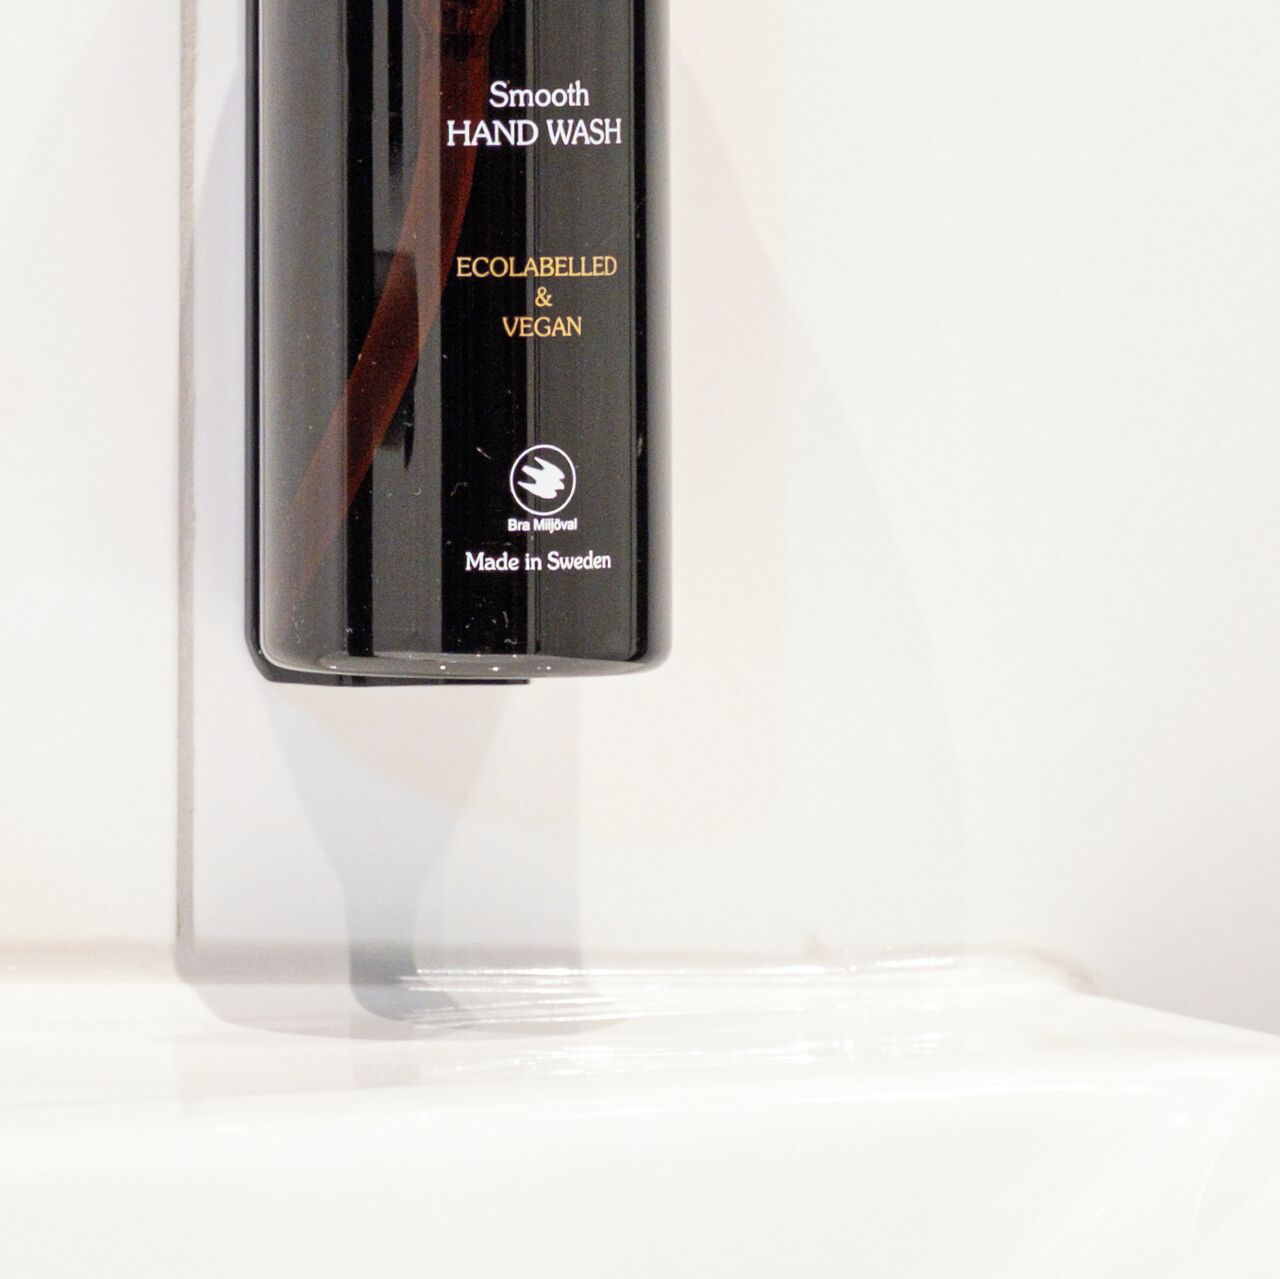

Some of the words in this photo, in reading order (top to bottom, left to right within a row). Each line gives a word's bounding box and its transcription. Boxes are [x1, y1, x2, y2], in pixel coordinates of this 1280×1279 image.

[489, 80, 589, 107] Smooth
[446, 120, 539, 146] HAND
[546, 118, 622, 145] WASH
[456, 256, 617, 277] ECOLABELLED
[535, 287, 552, 307] &
[503, 316, 582, 337] VEGAN
[508, 519, 530, 531] Bra
[533, 518, 578, 534] Miljöval
[465, 552, 519, 571] Made
[525, 552, 542, 571] in
[547, 551, 611, 570] Sweden
